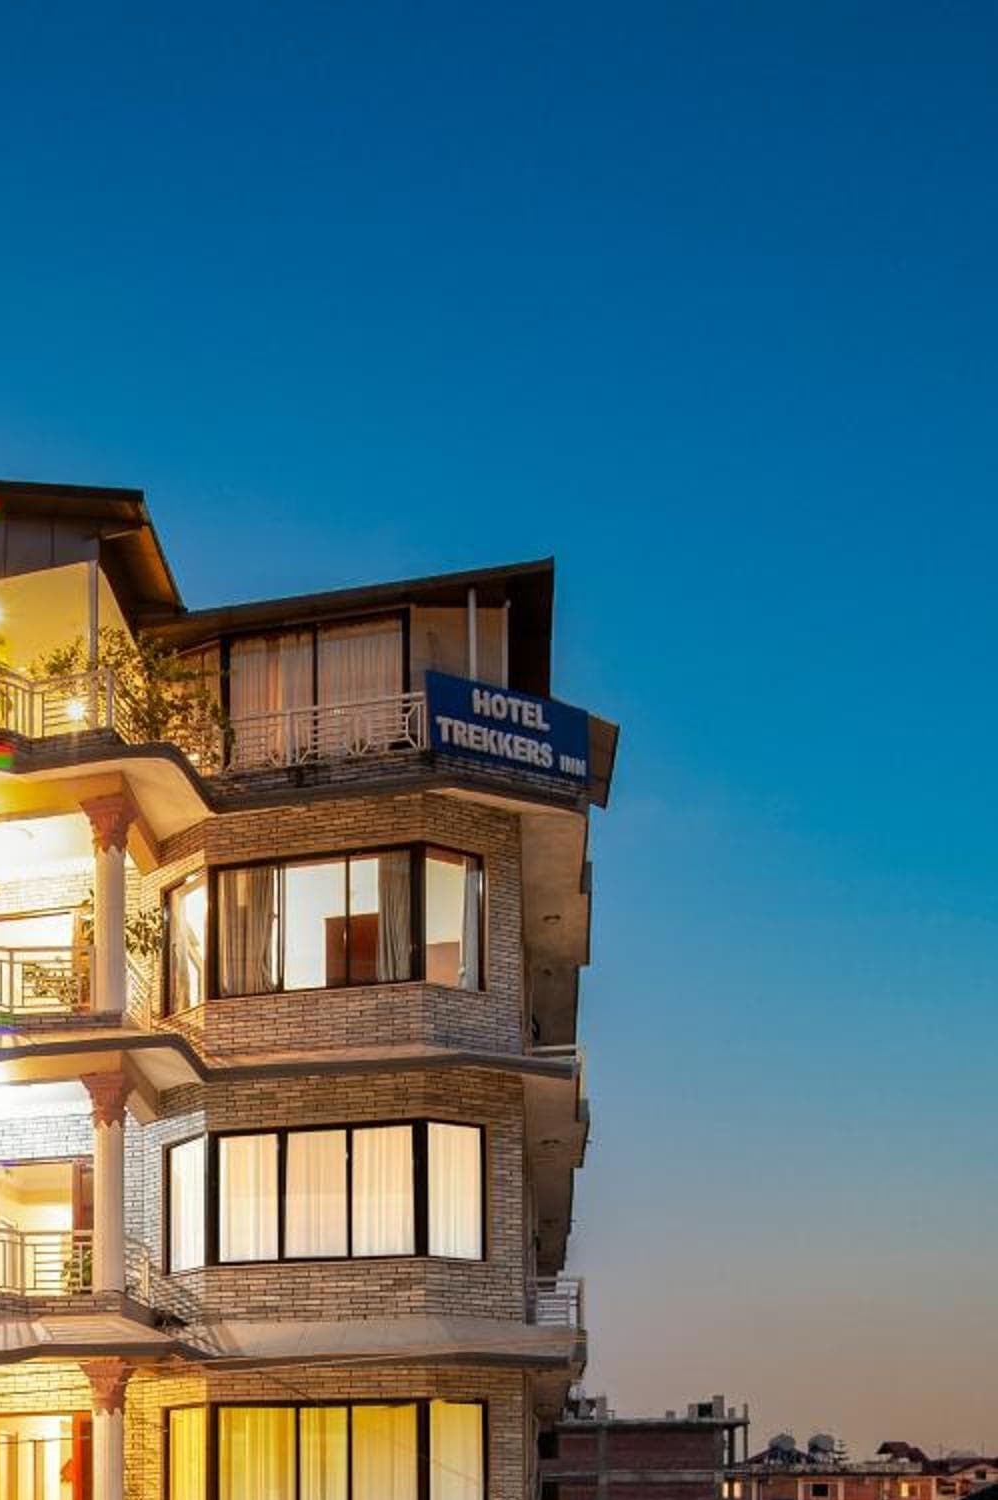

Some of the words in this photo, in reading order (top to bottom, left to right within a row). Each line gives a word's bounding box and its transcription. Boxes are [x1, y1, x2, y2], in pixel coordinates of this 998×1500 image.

[472, 688, 551, 732] HOTEL
[435, 715, 553, 769] TREKKERS
[559, 754, 587, 777] INN
